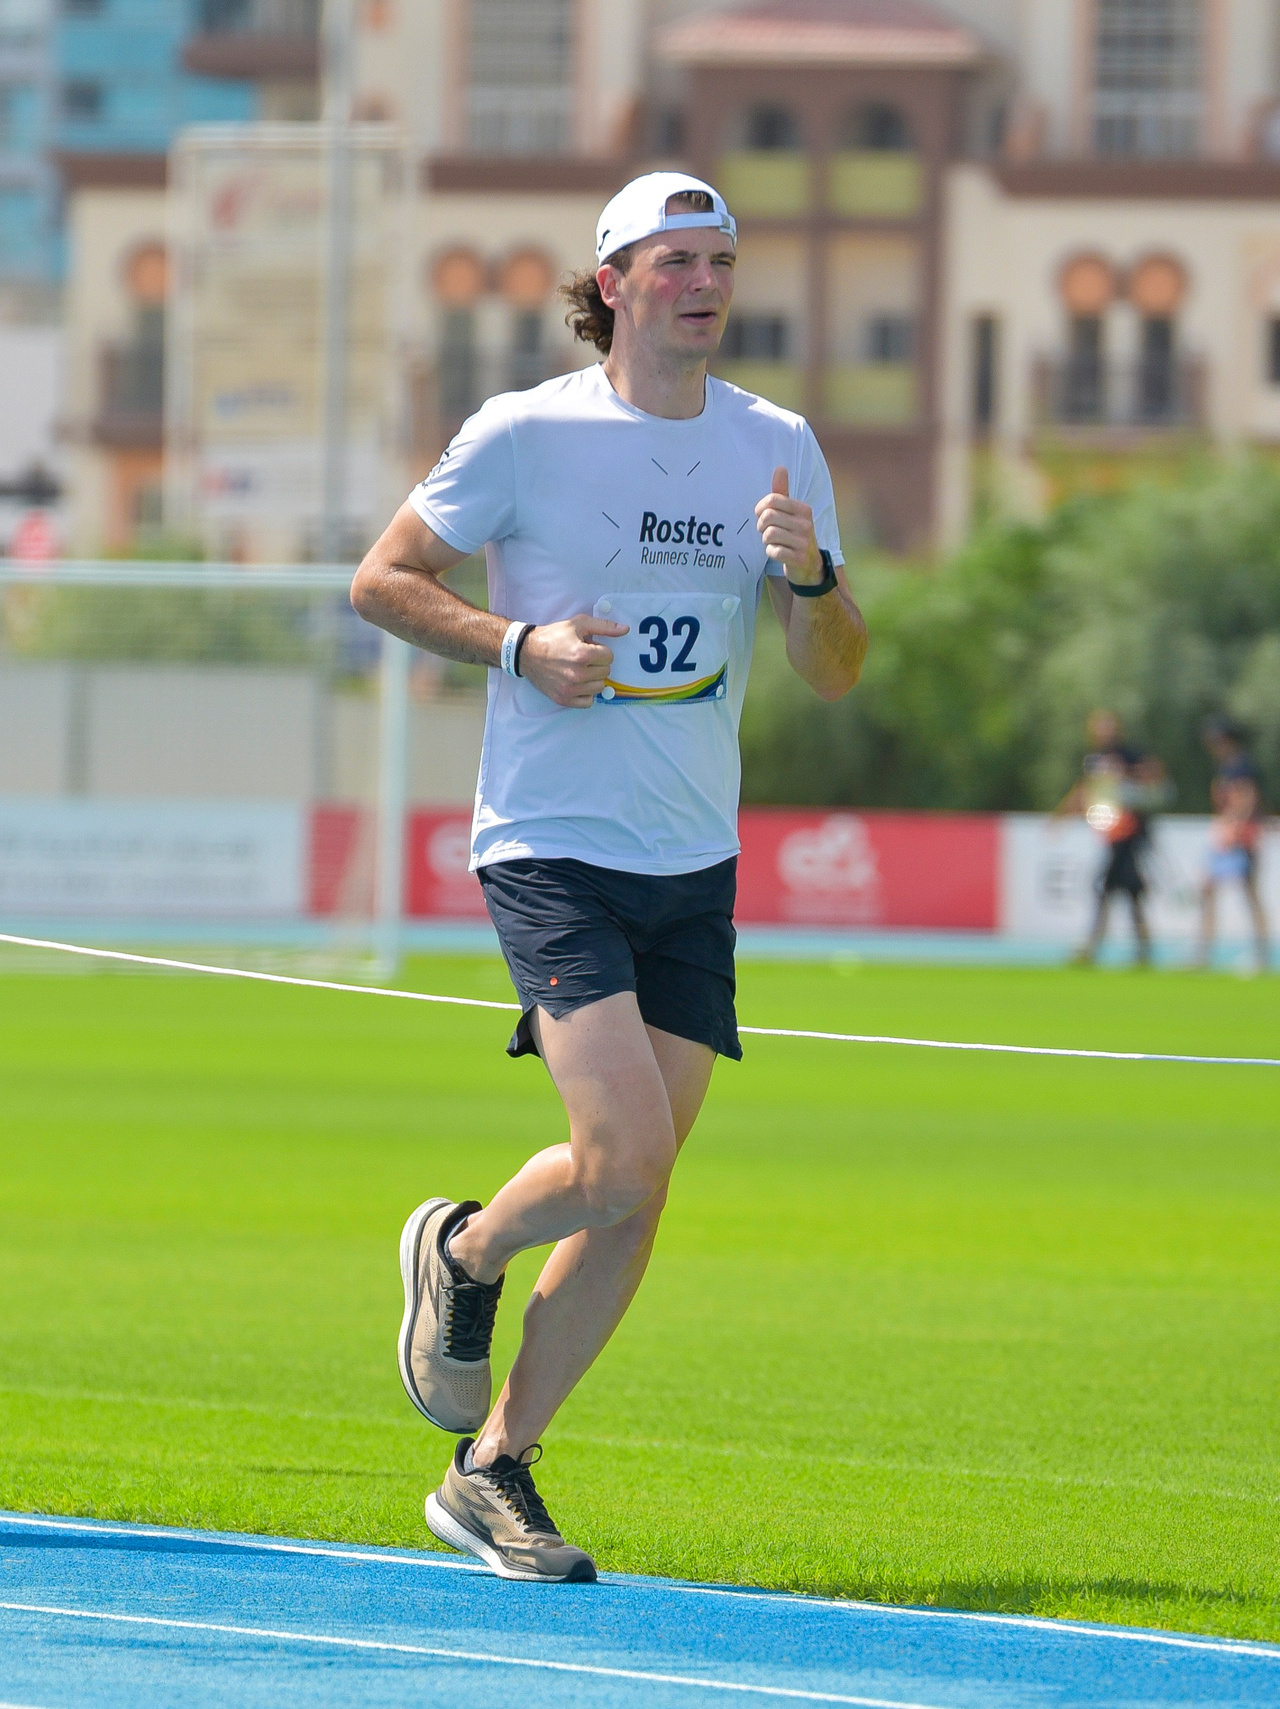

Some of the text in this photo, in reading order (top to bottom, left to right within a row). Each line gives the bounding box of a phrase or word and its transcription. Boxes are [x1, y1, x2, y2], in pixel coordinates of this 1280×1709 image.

[639, 510, 726, 547] Rostec
[640, 546, 727, 570] Runners Team
[638, 614, 701, 674] 32
